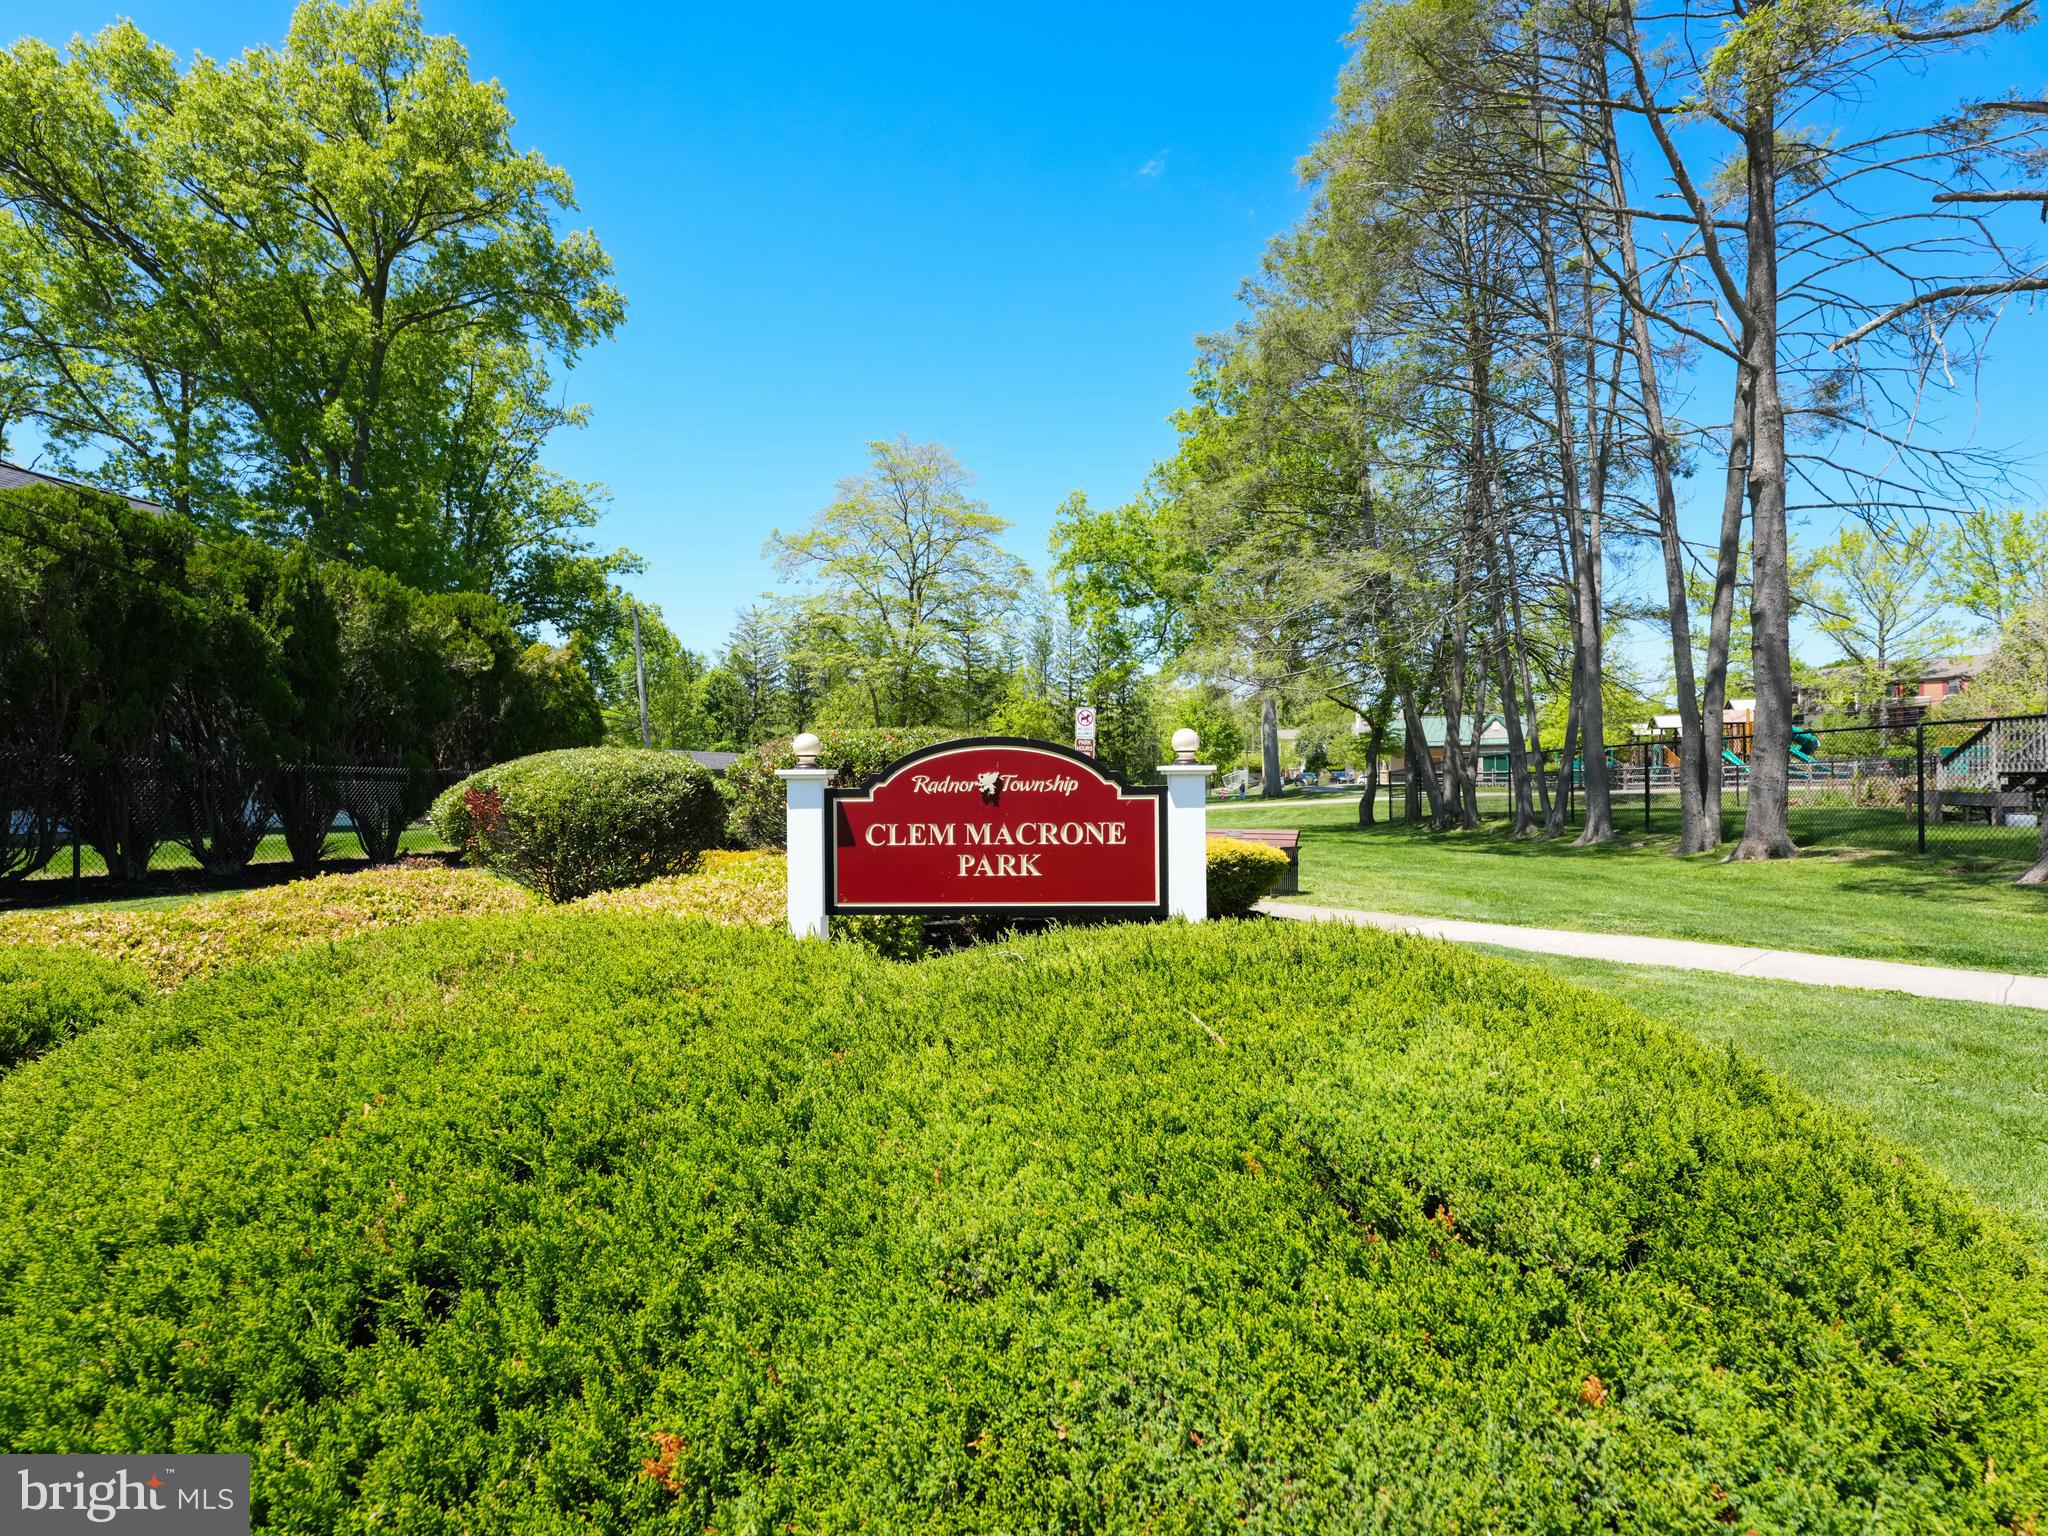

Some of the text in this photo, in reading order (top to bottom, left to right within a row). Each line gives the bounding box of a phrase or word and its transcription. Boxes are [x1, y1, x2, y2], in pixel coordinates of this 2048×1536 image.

[911, 774, 1079, 797] Radnor Township
[865, 821, 1127, 846] CLEM MACRONE
[956, 853, 1043, 877] PARK
